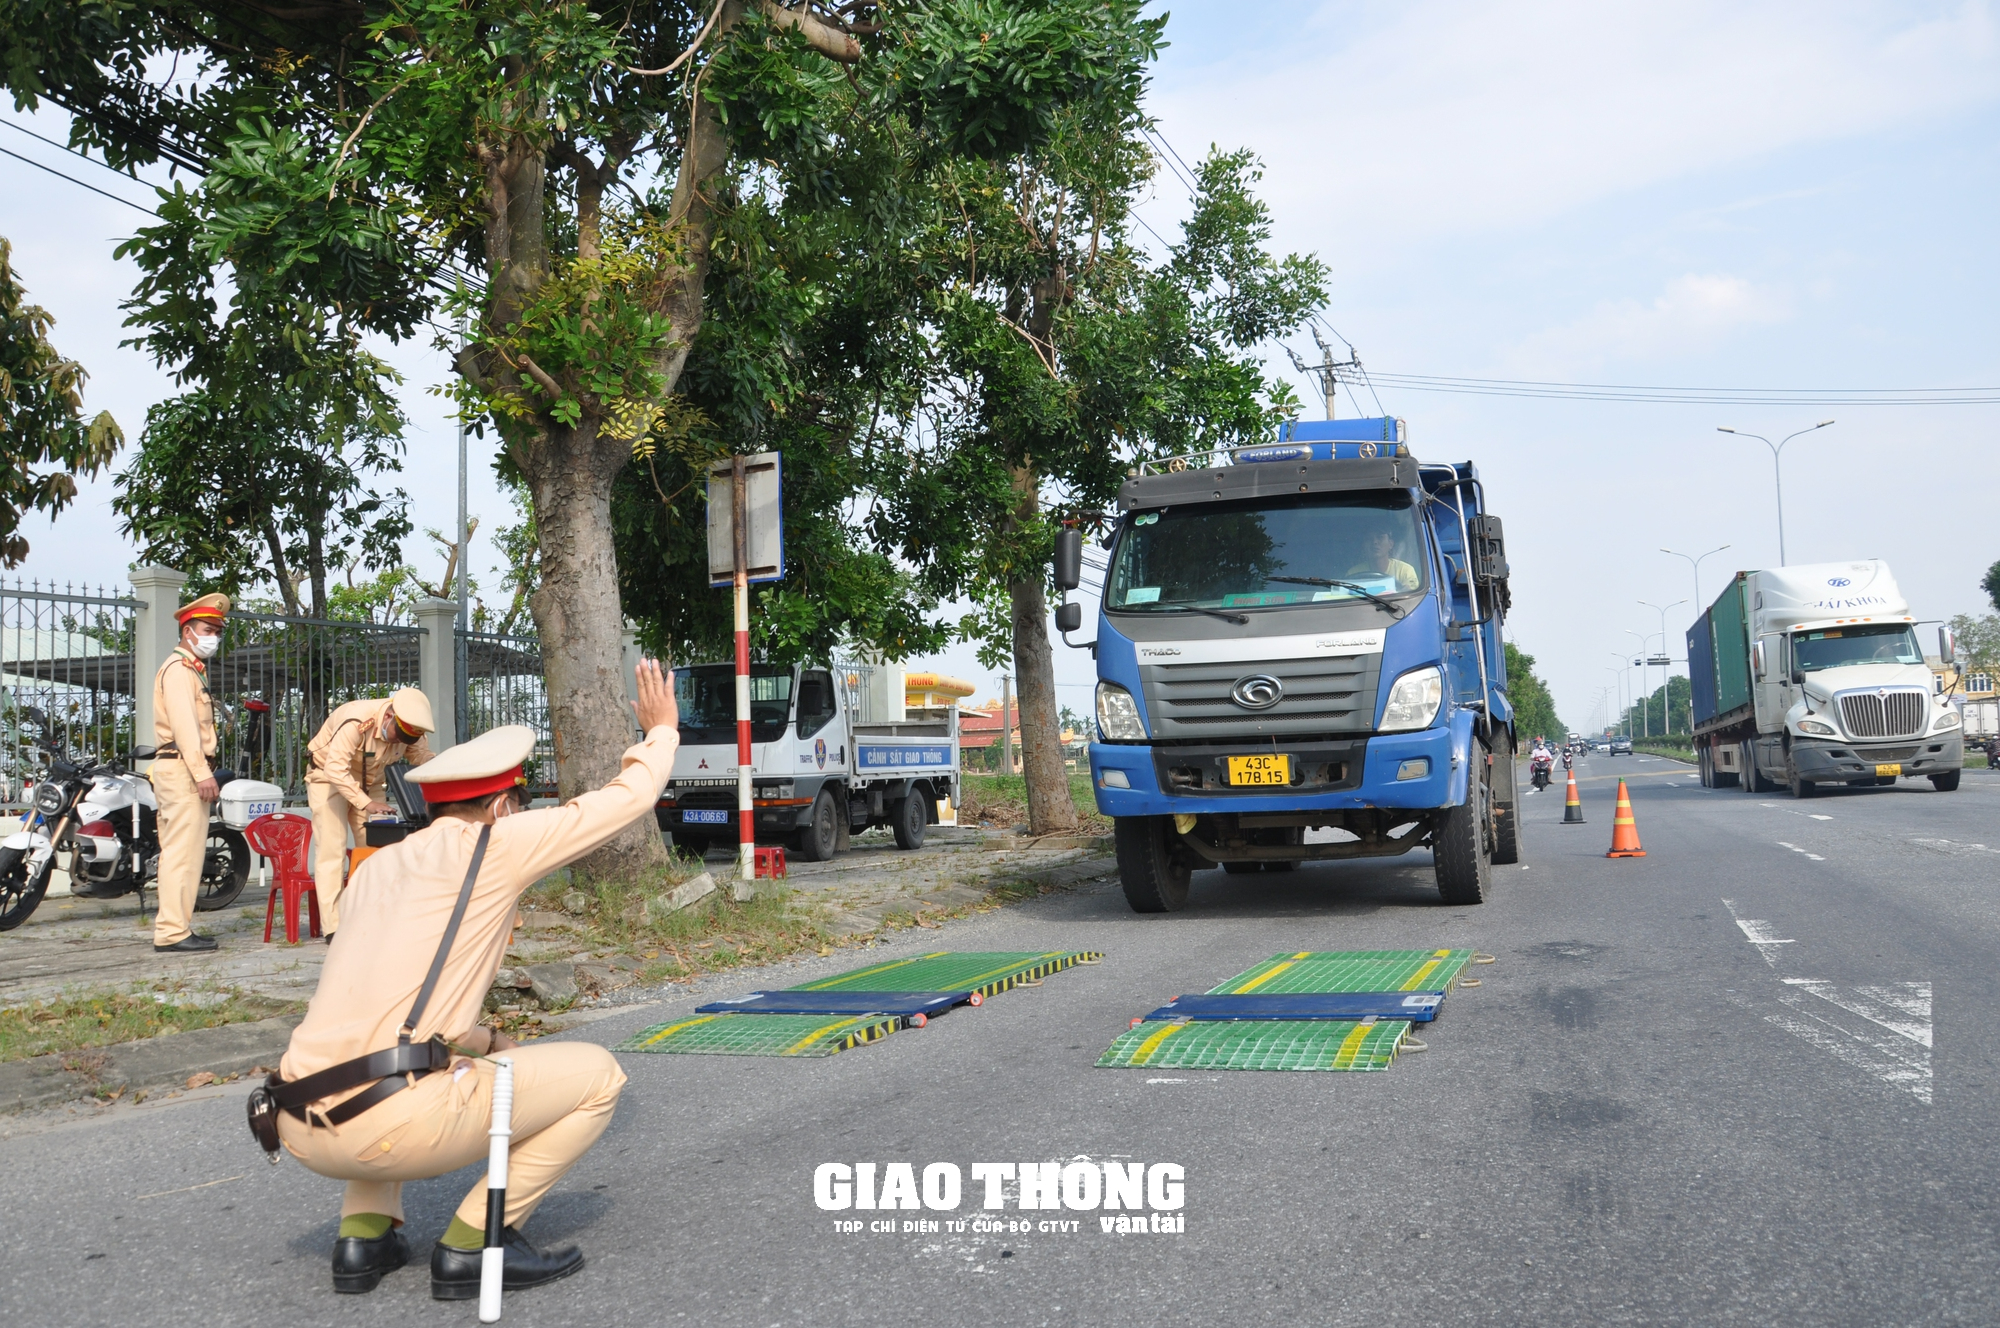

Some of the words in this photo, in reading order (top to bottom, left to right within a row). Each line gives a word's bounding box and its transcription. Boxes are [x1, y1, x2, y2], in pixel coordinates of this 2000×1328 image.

[1844, 595, 1887, 608] KHOA
[1316, 637, 1378, 649] FORLAND
[1141, 647, 1182, 656] THACO
[867, 748, 887, 765] CẢNH
[889, 749, 903, 764] SÁT
[905, 751, 920, 764] GIAO
[922, 748, 942, 764] THÔNG
[1245, 757, 1271, 770] 43C
[675, 779, 737, 787] MITSUBISHI
[1238, 770, 1283, 784] 178.15
